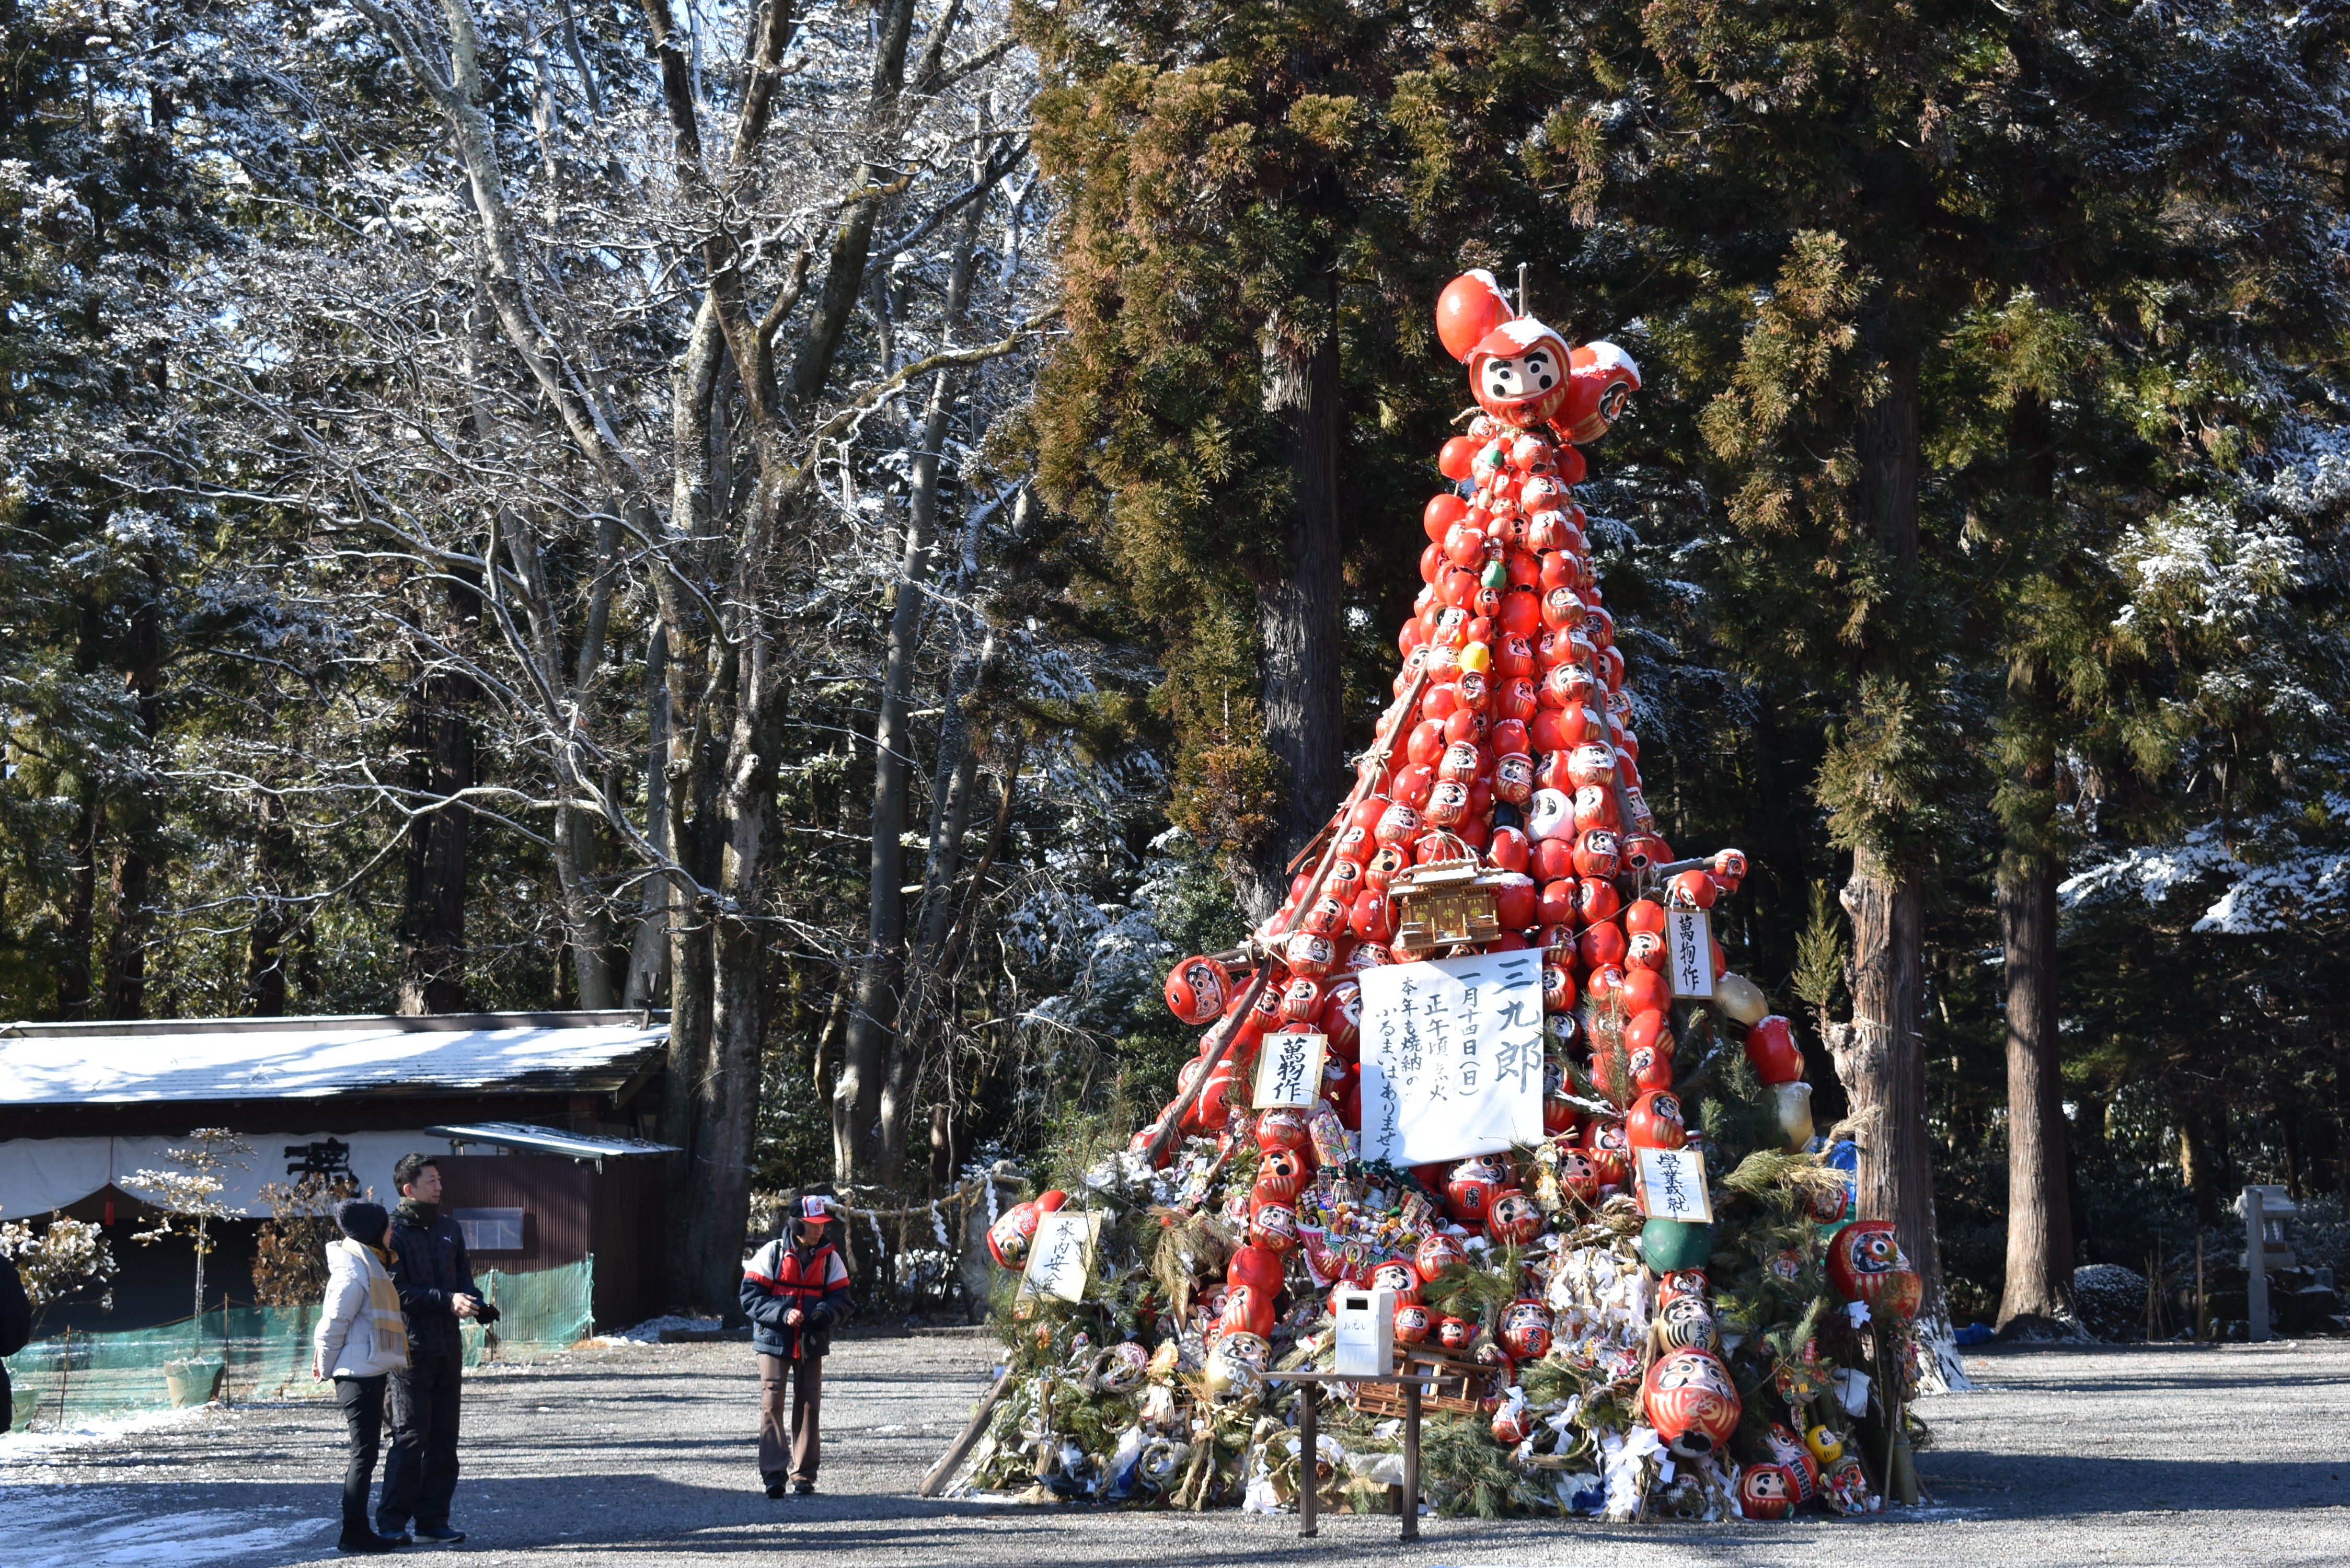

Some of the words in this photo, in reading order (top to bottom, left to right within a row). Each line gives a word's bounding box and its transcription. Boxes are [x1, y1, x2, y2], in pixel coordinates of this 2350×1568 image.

[1678, 915, 1699, 990] 萬物作
[1492, 958, 1542, 1094] 三九郎
[1272, 1036, 1308, 1102] 萬物作
[1656, 1153, 1690, 1212] 學業成就
